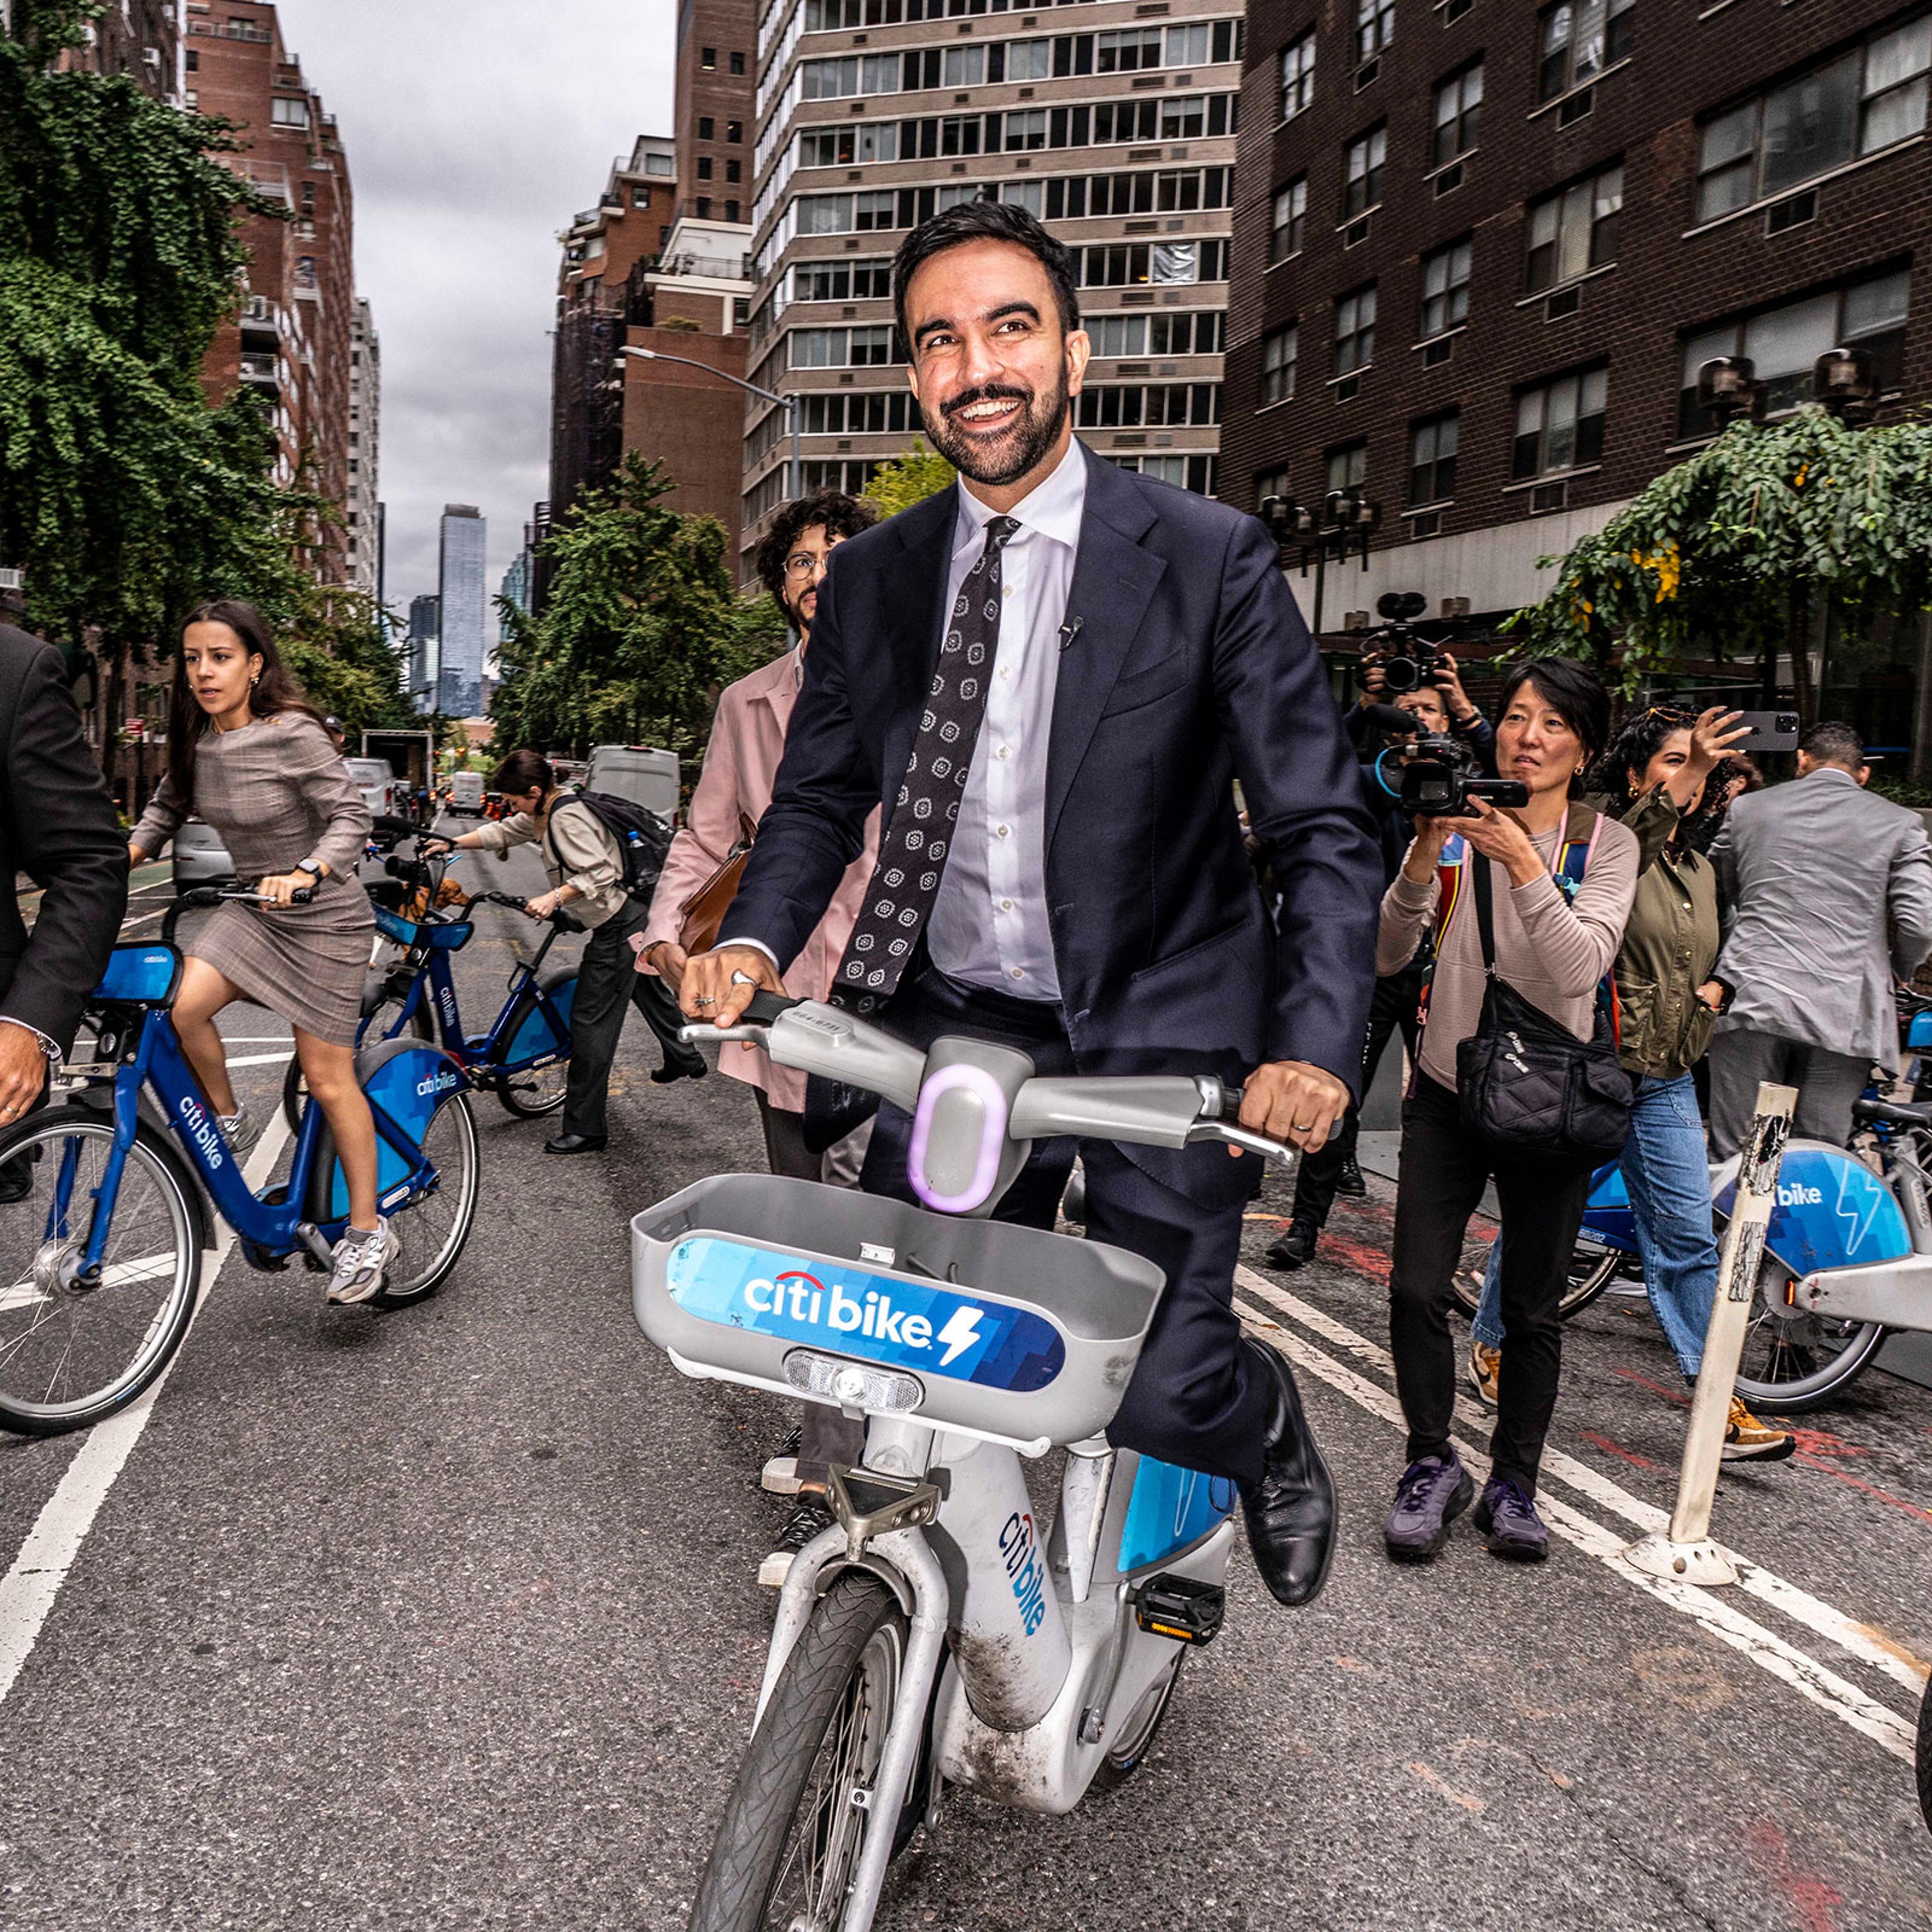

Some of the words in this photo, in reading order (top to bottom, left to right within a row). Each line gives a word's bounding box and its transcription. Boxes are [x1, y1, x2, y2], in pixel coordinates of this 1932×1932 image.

[179, 1096, 205, 1131] citi
[194, 1121, 223, 1170] bike
[1777, 1182, 1823, 1206] bike
[744, 1270, 826, 1324] citi
[999, 1512, 1033, 1578] citi
[1012, 1546, 1045, 1636] bike
